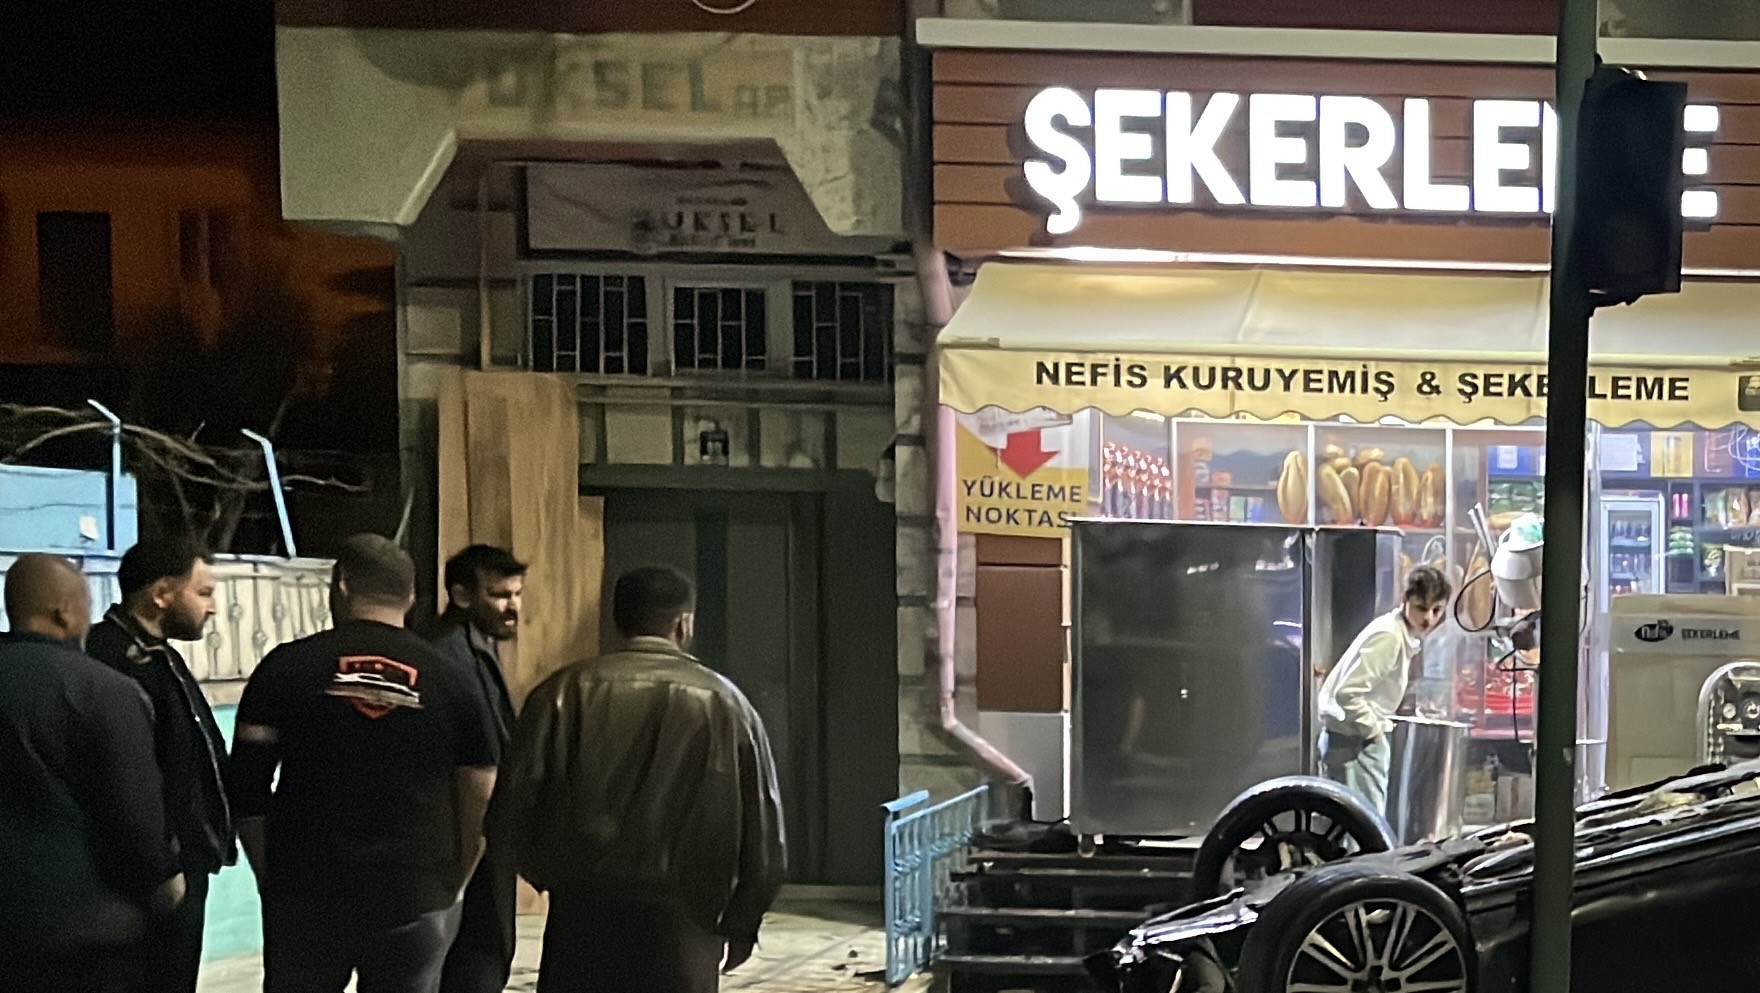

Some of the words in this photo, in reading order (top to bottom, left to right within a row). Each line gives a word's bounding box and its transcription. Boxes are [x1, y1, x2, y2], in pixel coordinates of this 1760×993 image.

[1022, 86, 1720, 235] ŞEKERLEE
[1035, 357, 1148, 388] NEFİS
[1164, 362, 1395, 402] KURUYEMİŞ
[1415, 371, 1442, 396] &
[1457, 372, 1691, 402] ŞEKELEME
[962, 475, 1082, 503] YÜKLEME
[965, 505, 1077, 528] NOKTAS
